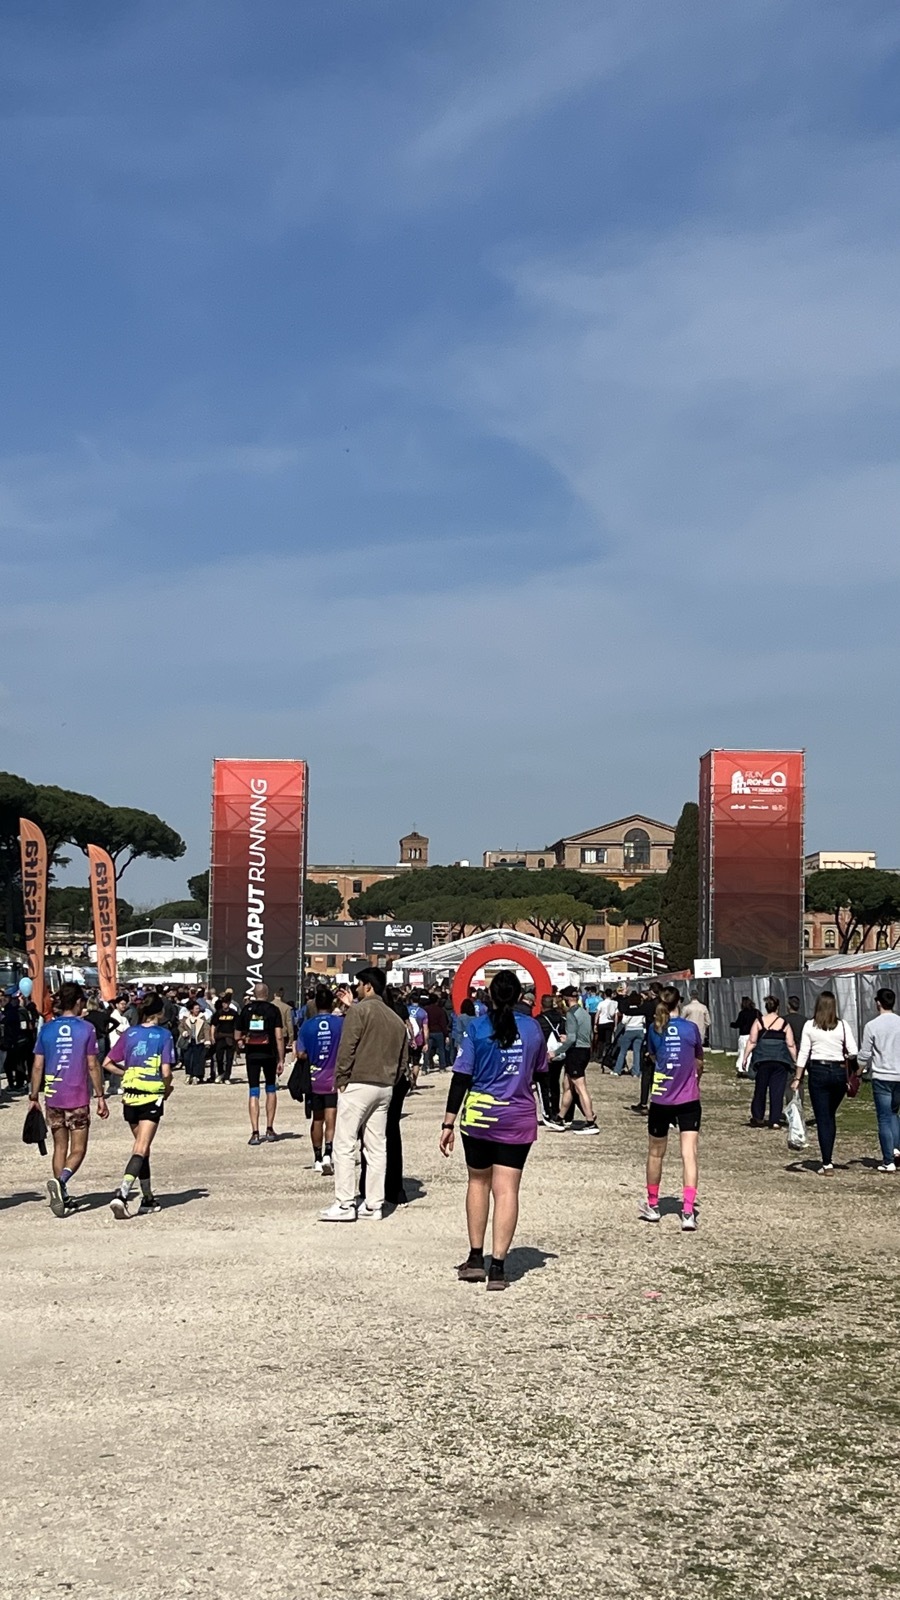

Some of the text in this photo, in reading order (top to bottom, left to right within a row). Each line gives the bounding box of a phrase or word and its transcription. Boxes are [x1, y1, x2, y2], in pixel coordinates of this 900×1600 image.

[745, 771, 763, 779] RUN
[746, 778, 771, 786] ROME
[245, 778, 268, 1000] MA CAPUT RUNNING
